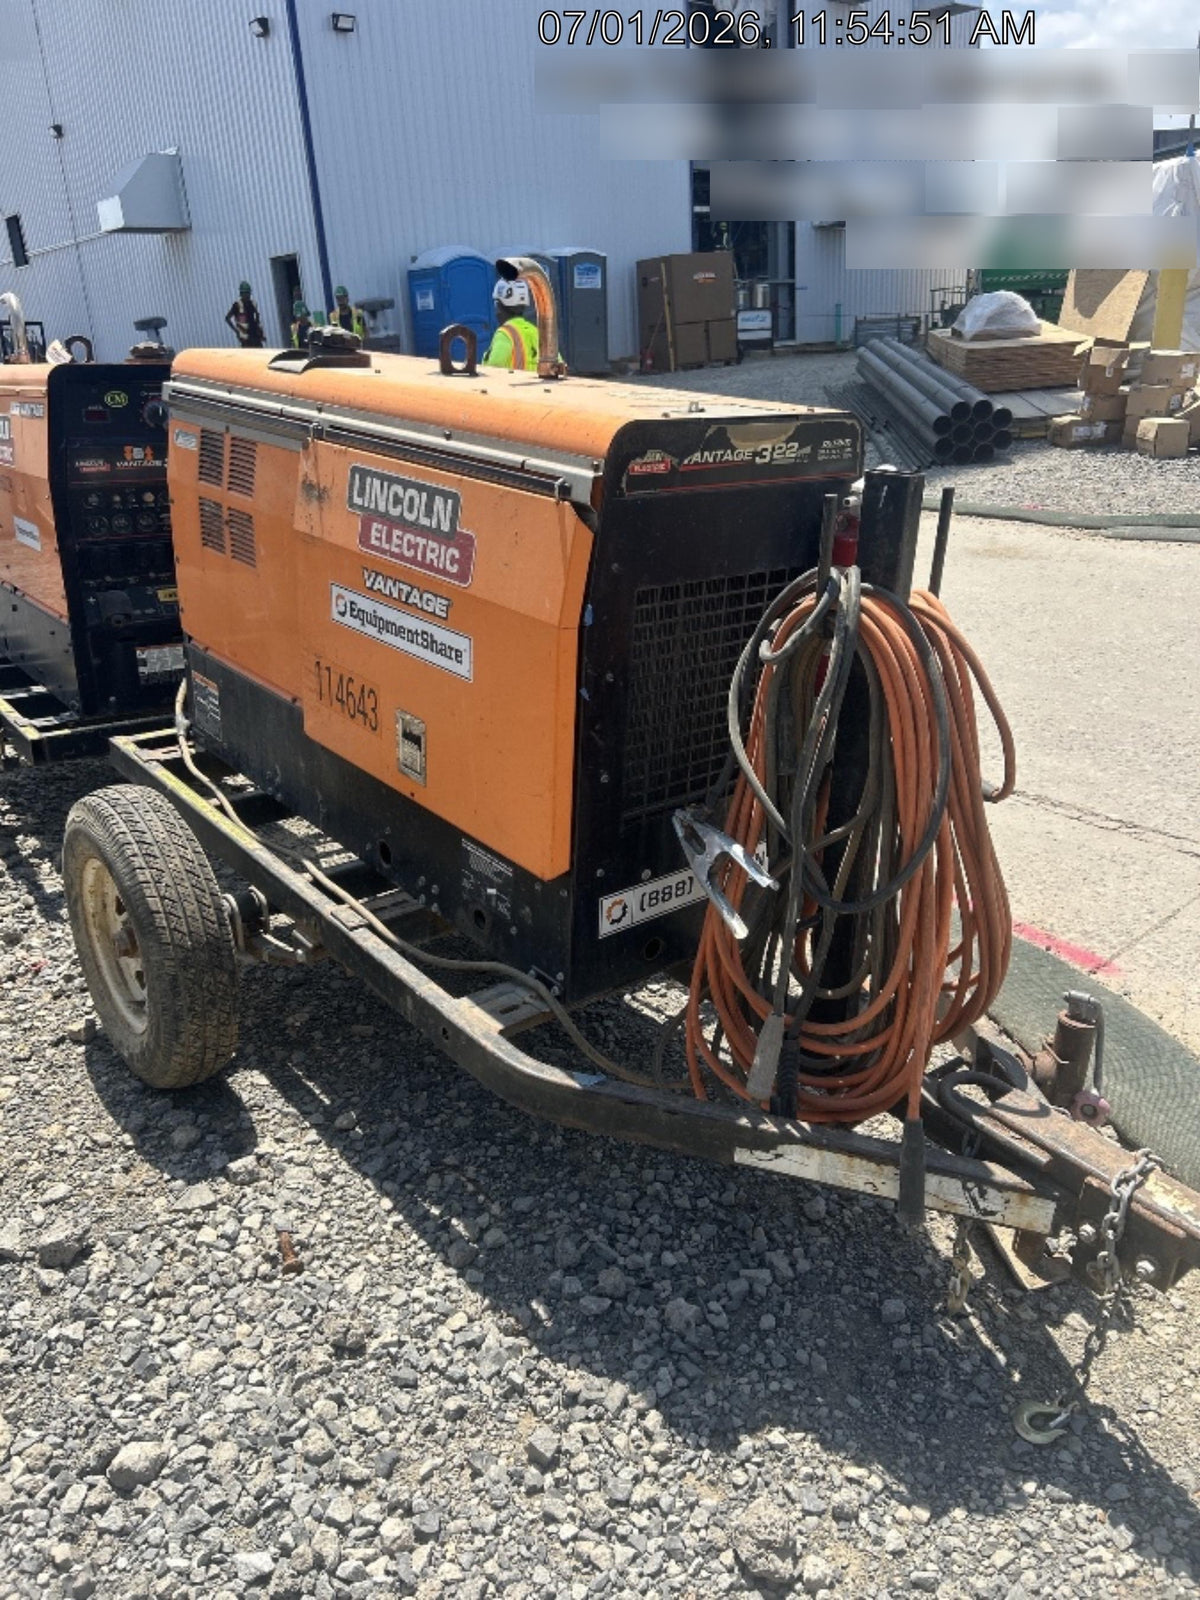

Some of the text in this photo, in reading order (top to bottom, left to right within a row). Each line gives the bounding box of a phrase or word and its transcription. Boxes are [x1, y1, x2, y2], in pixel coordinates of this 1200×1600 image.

[755, 442, 799, 464] 322
[353, 473, 453, 532] LINCOLN
[370, 523, 460, 574] ELECTRIC
[363, 568, 452, 619] VANTAGE
[350, 601, 464, 666] EquipmentShare
[315, 661, 378, 732] 114643
